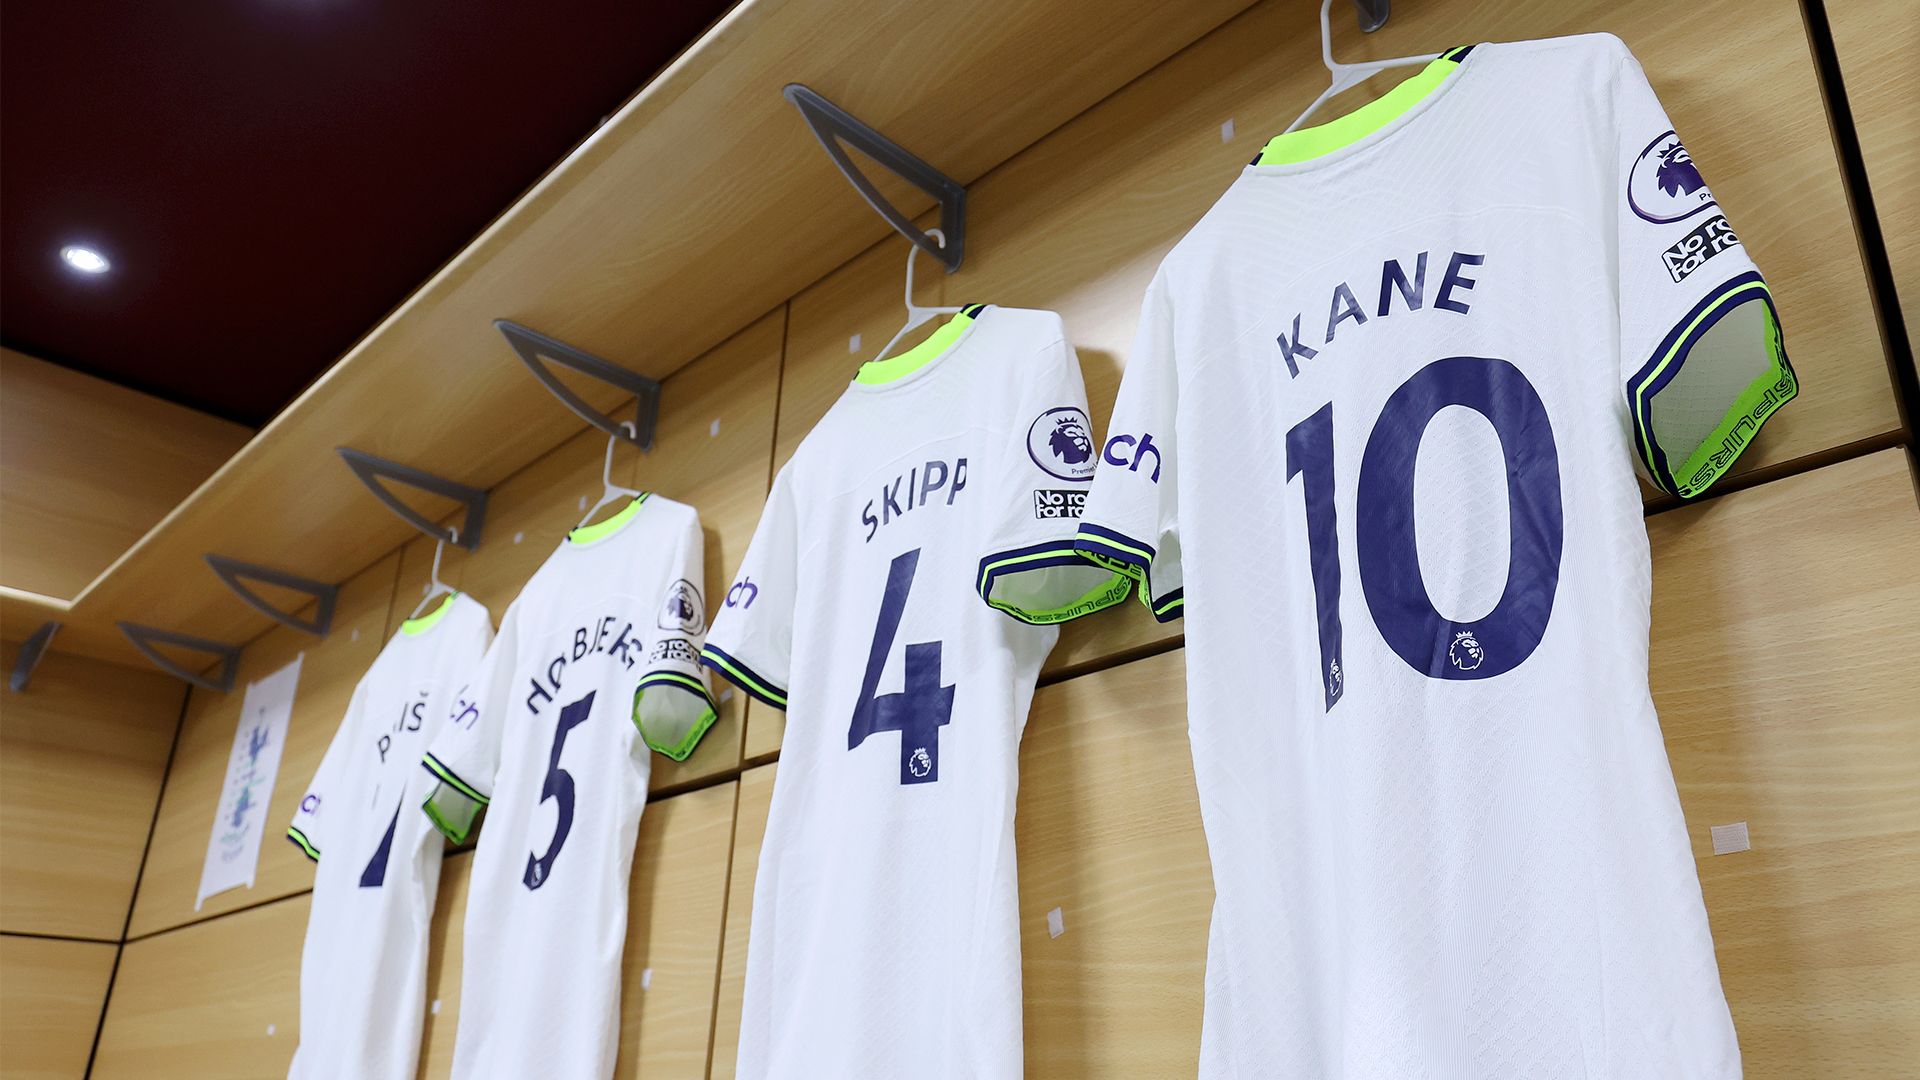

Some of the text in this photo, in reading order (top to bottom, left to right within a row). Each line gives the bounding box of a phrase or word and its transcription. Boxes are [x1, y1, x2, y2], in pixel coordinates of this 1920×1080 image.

[1276, 251, 1485, 380] KANE
[1662, 234, 1704, 270] No
[861, 458, 968, 544] SKIPP
[1034, 490, 1065, 506] No
[1285, 356, 1564, 714] 10
[847, 547, 956, 785] 4
[523, 689, 597, 891] 5
